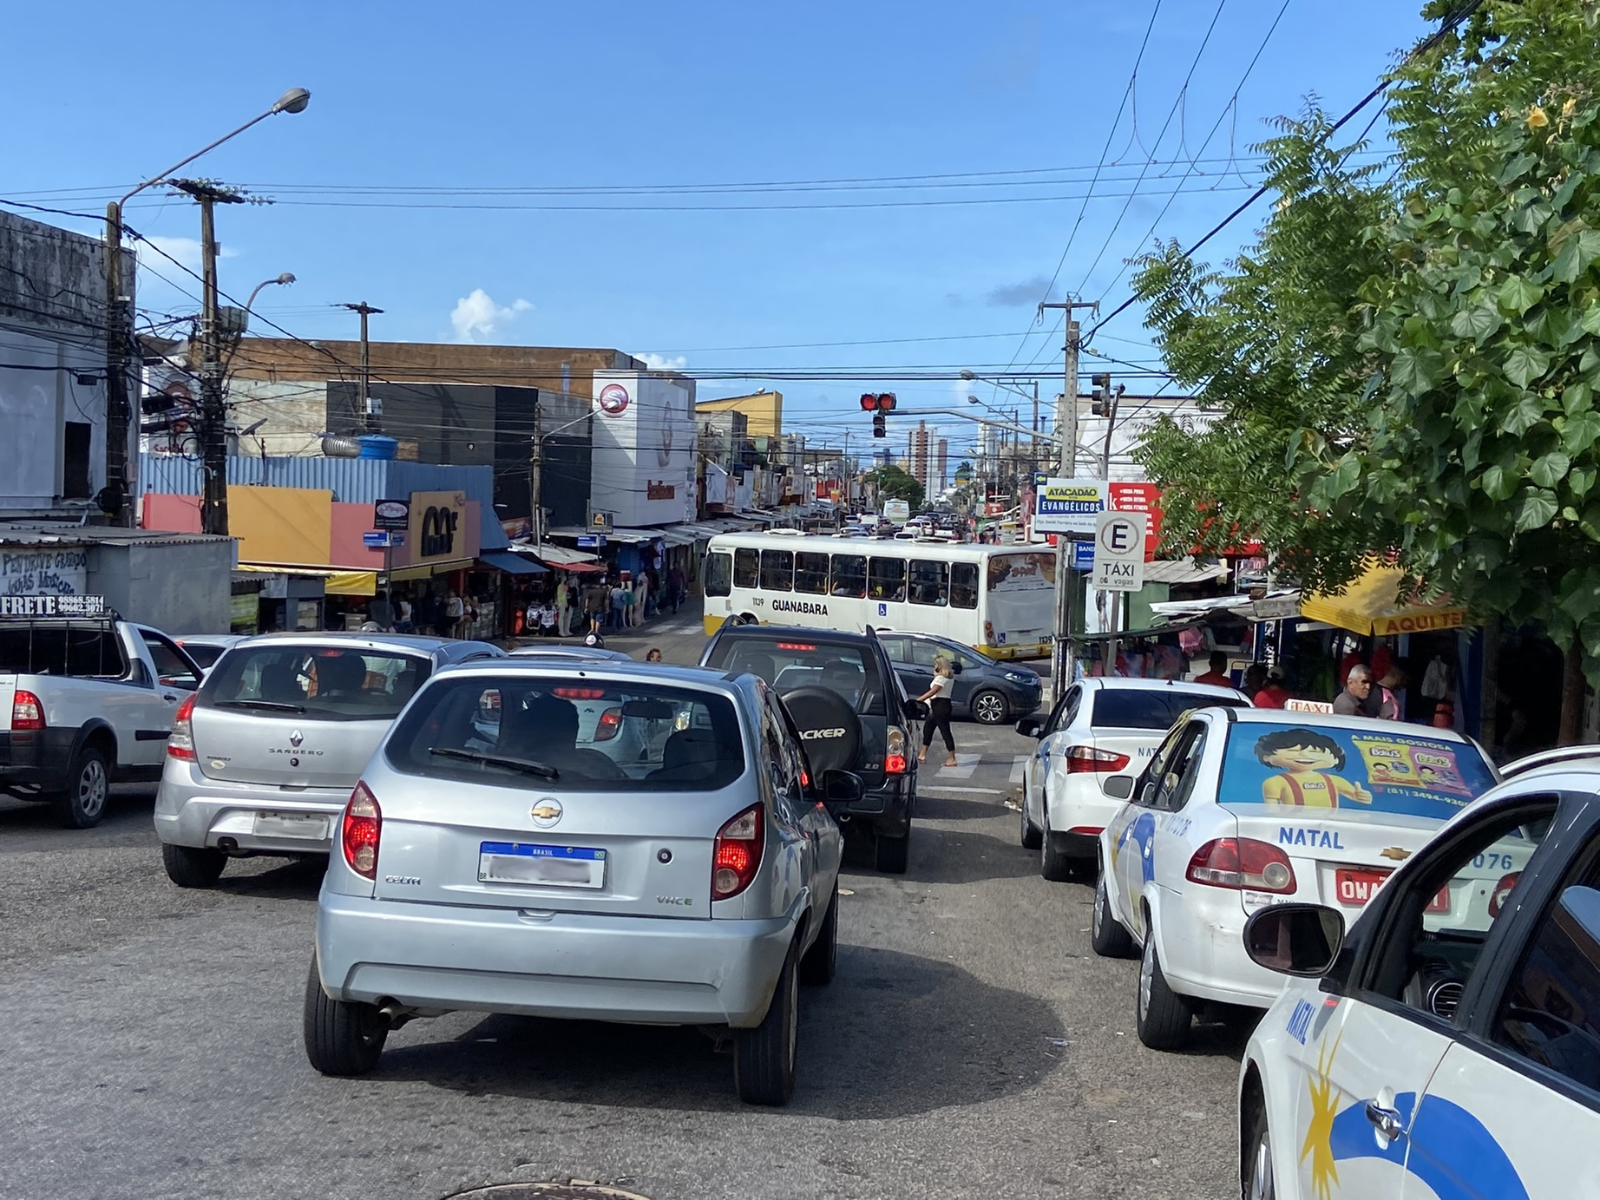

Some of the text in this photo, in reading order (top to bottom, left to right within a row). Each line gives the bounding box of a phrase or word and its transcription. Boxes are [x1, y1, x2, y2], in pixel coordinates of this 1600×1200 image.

[1042, 500, 1100, 512] EVANGÉLICOS
[1111, 524, 1128, 549] E
[1103, 561, 1134, 576] TÁXI
[1, 596, 55, 614] FRETE
[772, 599, 828, 616] GUANABARA
[1385, 615, 1436, 633] AQUI
[1291, 701, 1330, 714] TAXI
[1363, 735, 1393, 743] MAIS
[1396, 738, 1453, 751] GOSTOSA
[269, 748, 324, 756] SANDERO
[1279, 827, 1344, 850] NATAL
[533, 848, 553, 856] BRASIL
[1286, 998, 1316, 1046] NATAL
